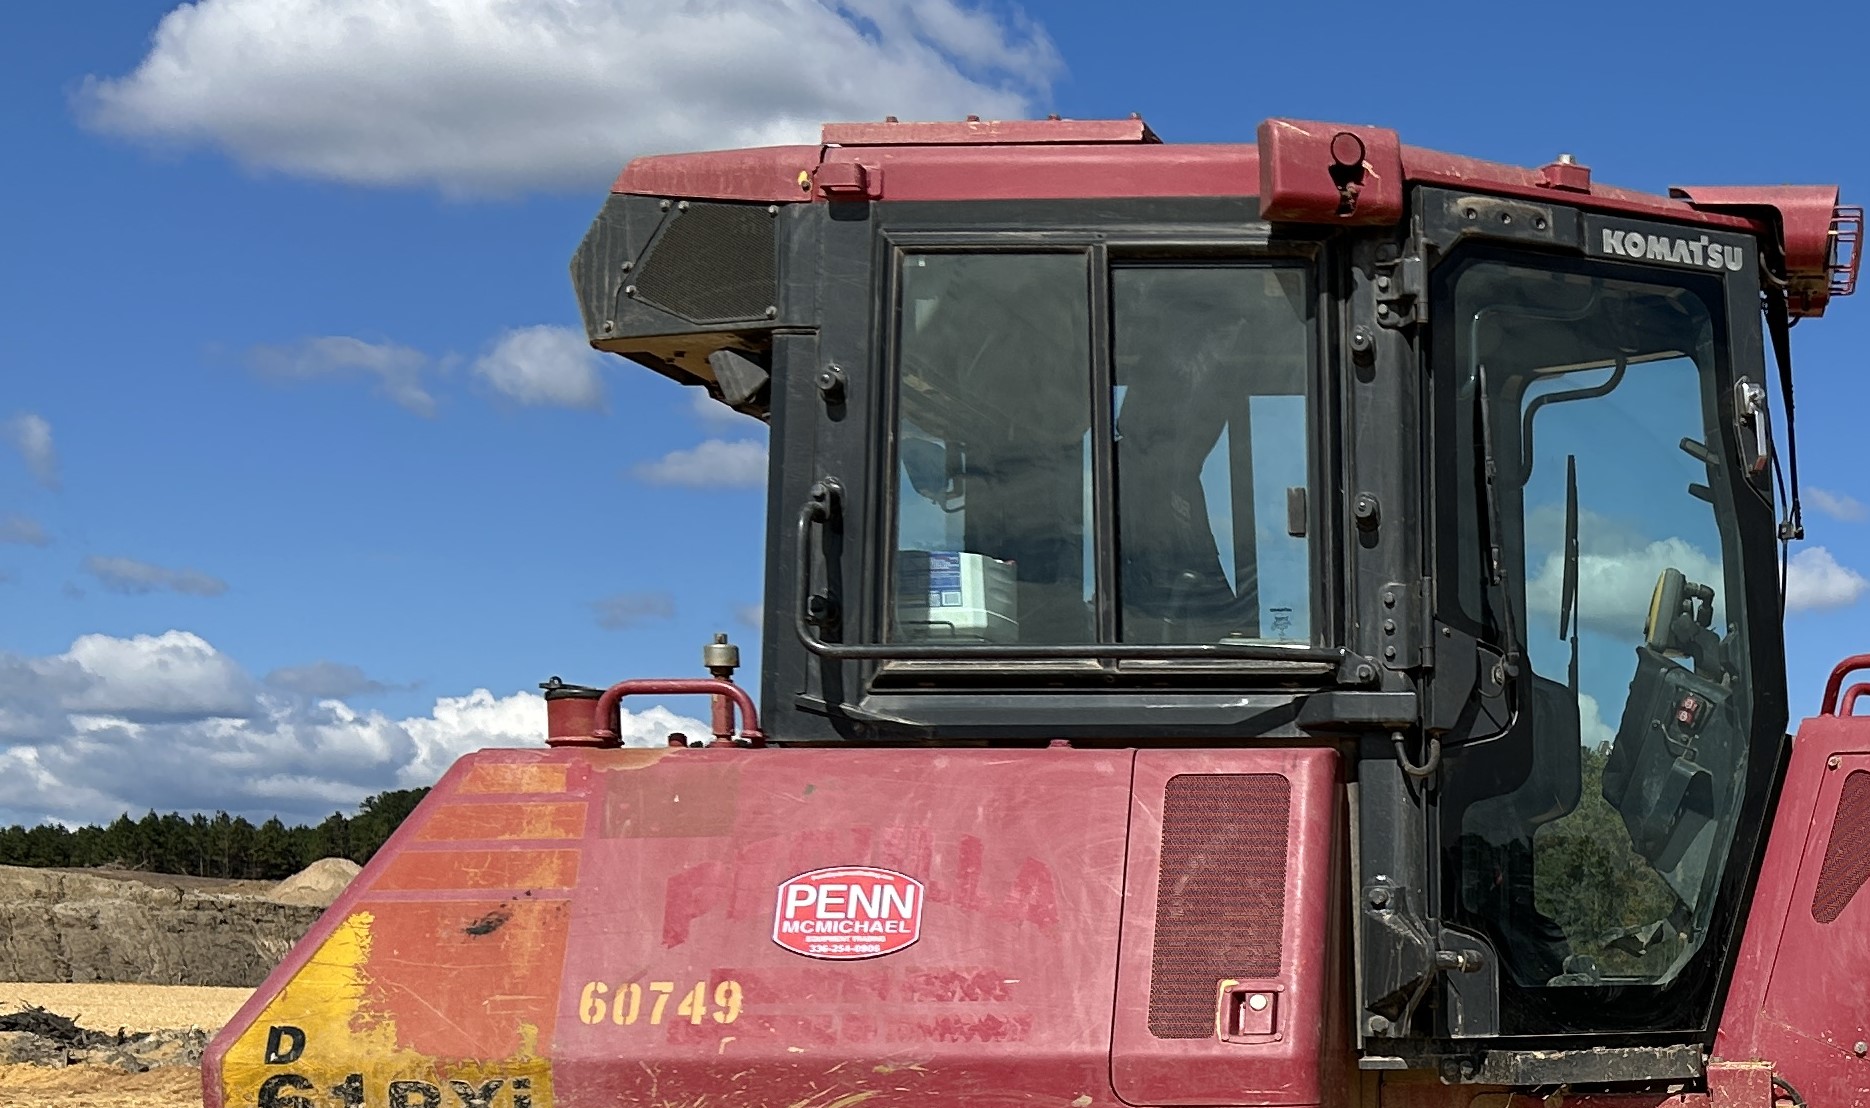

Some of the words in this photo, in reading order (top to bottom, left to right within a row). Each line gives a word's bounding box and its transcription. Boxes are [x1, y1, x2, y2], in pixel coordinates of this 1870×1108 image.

[1602, 228, 1743, 271] KOMATSU
[785, 884, 915, 919] PENN
[782, 920, 912, 933] MCMICHAEL
[579, 981, 743, 1026] 60749
[264, 1025, 306, 1065] D
